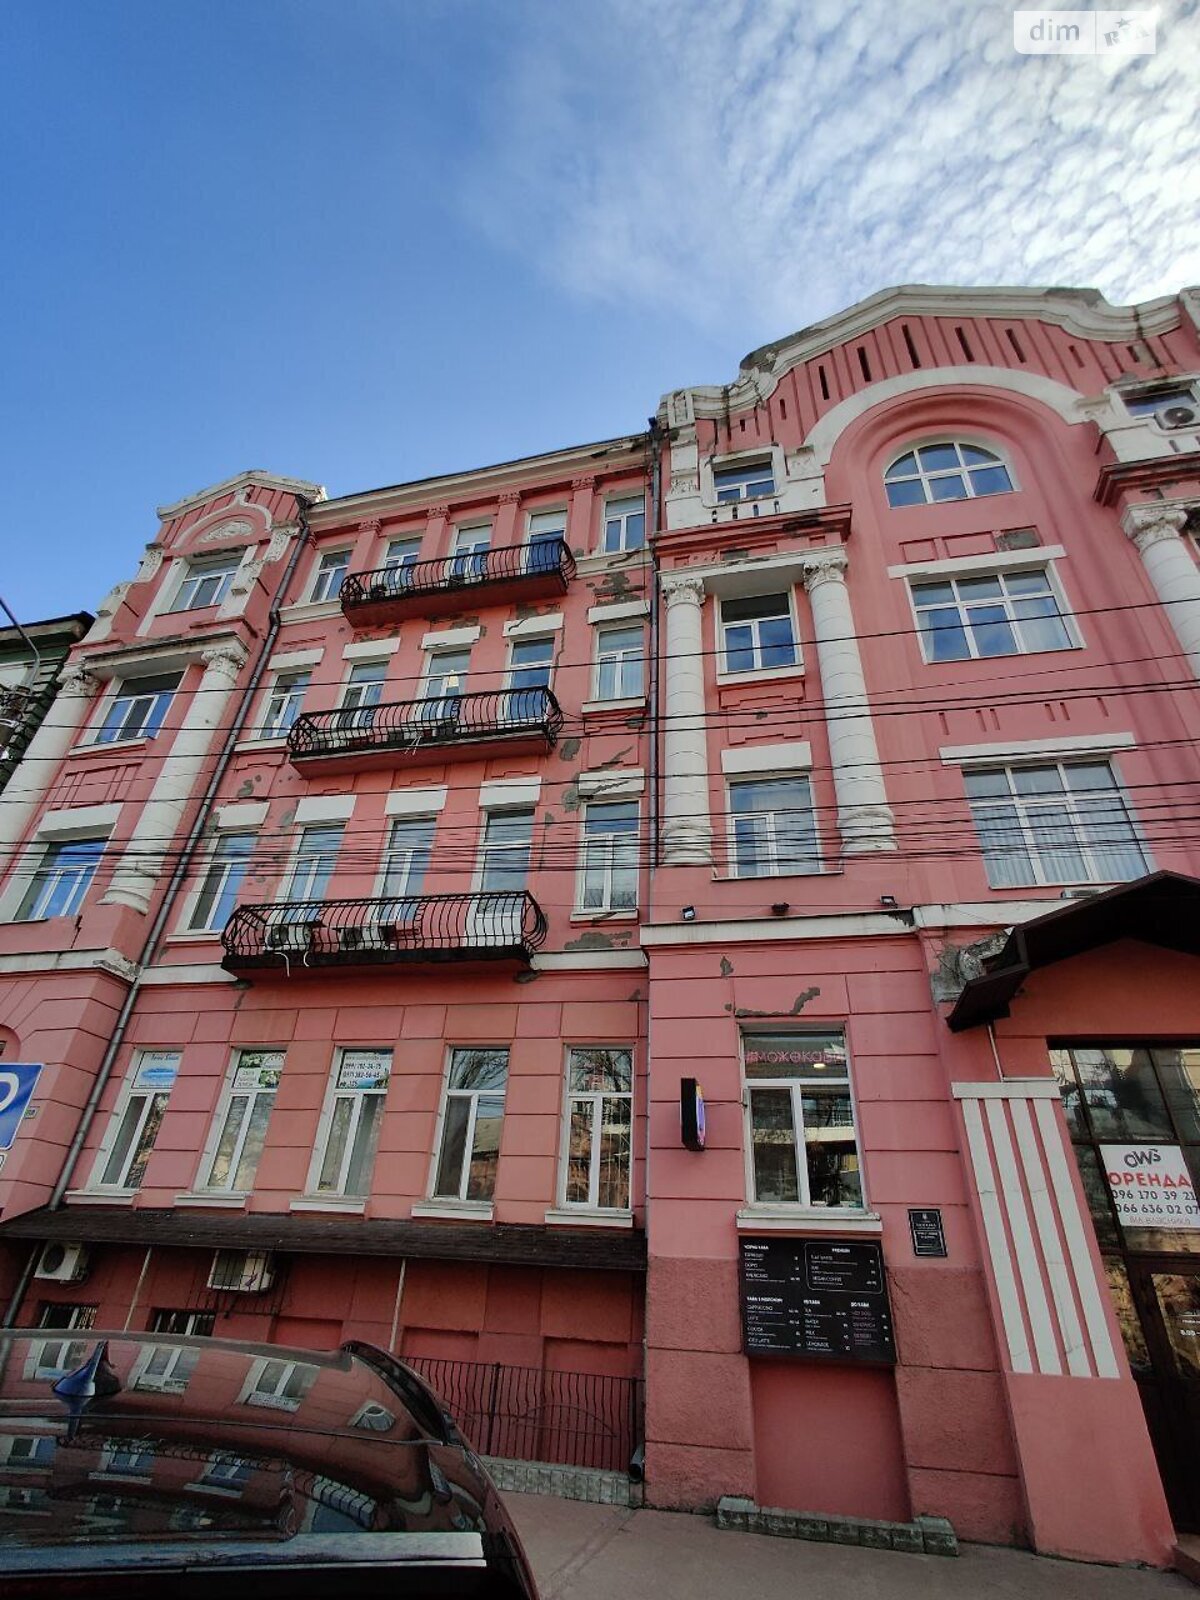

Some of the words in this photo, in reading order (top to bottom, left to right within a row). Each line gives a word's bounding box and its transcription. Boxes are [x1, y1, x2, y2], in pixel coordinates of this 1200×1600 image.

[1108, 1172, 1191, 1188] ОРЕНДА
[1112, 1189, 1134, 1200] 096
[1138, 1190, 1158, 1200] 170
[1162, 1190, 1177, 1200] 39
[1115, 1204, 1138, 1214] 066
[1141, 1204, 1163, 1214] 636
[1166, 1204, 1181, 1215] 02
